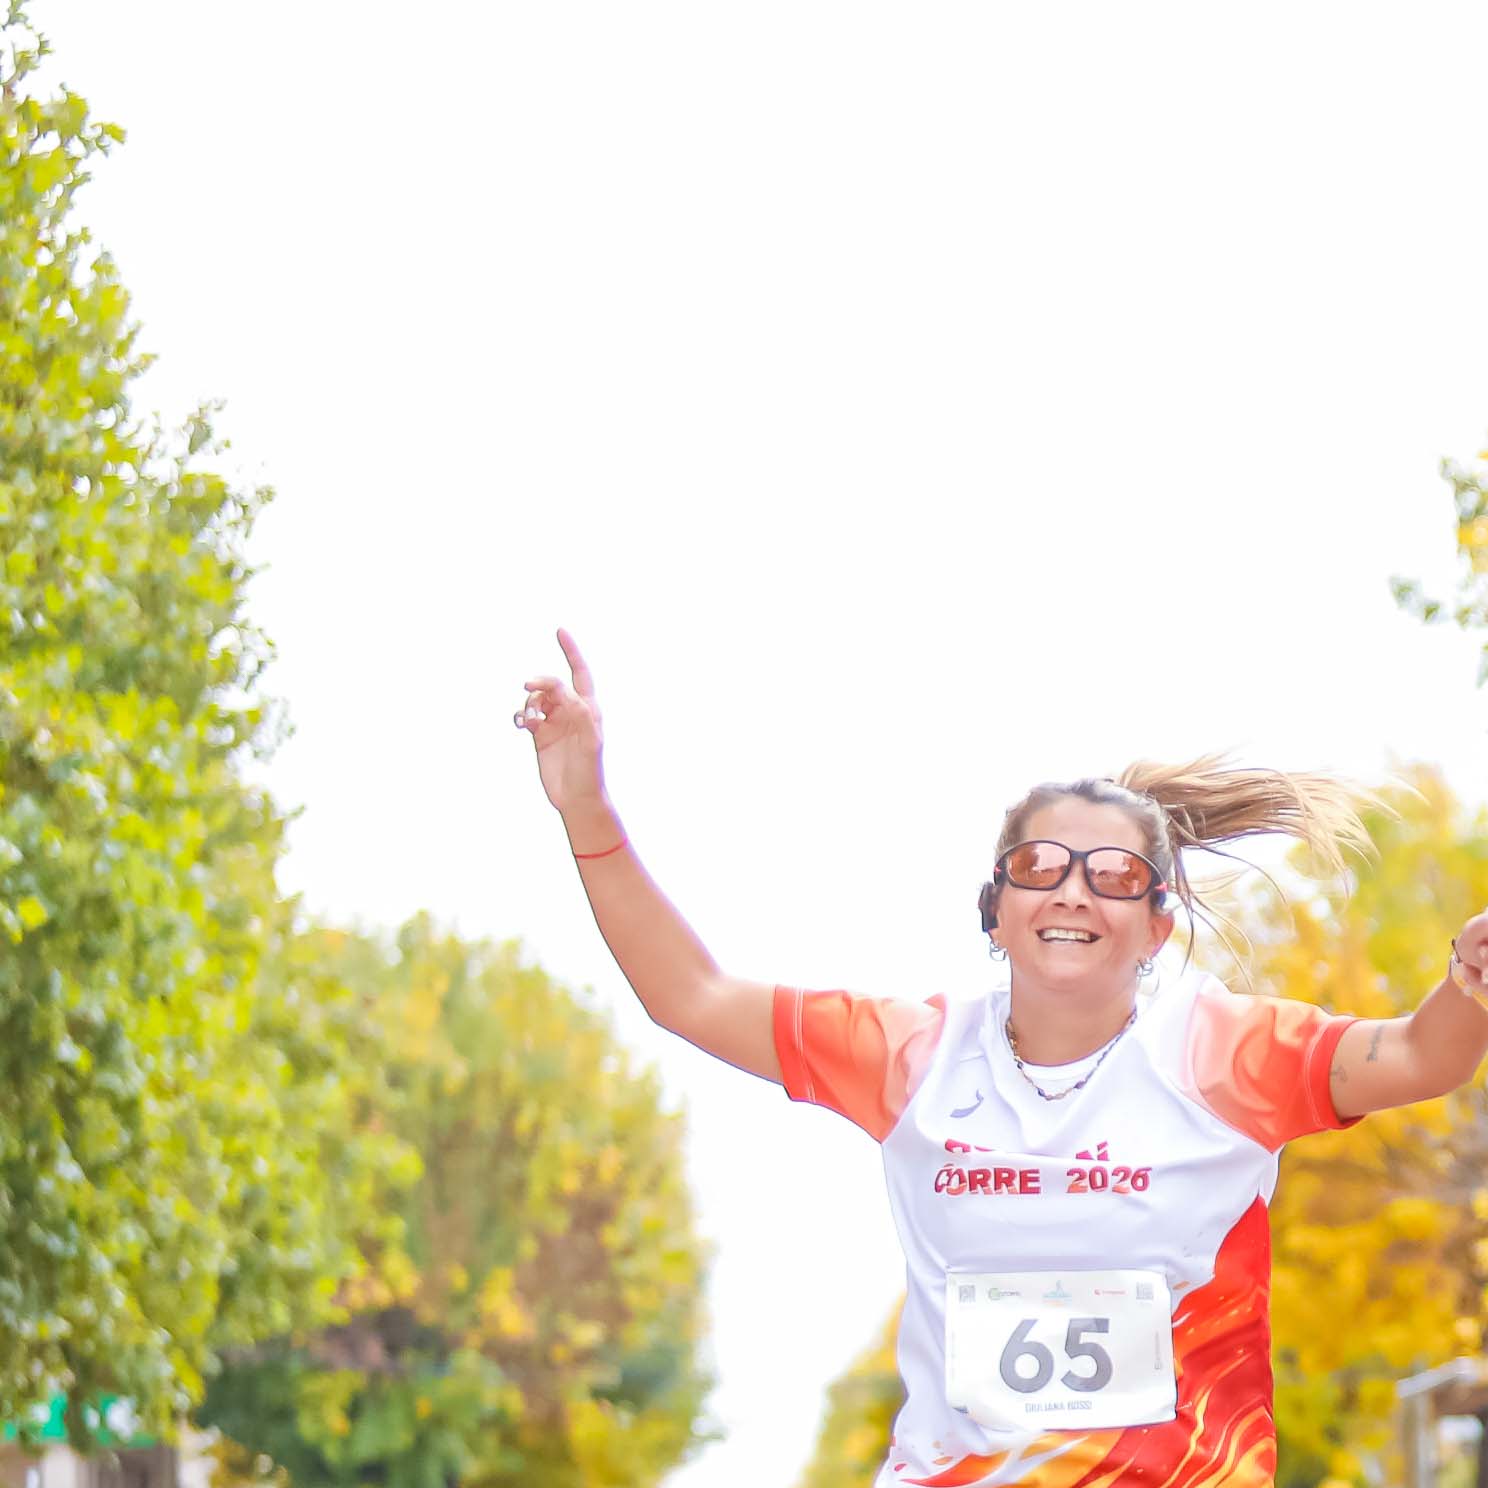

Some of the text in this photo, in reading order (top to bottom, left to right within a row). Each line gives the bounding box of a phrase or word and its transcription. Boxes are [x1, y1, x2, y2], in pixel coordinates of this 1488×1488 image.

[934, 1163, 1152, 1196] CORRE 2026
[999, 1317, 1114, 1394] 65
